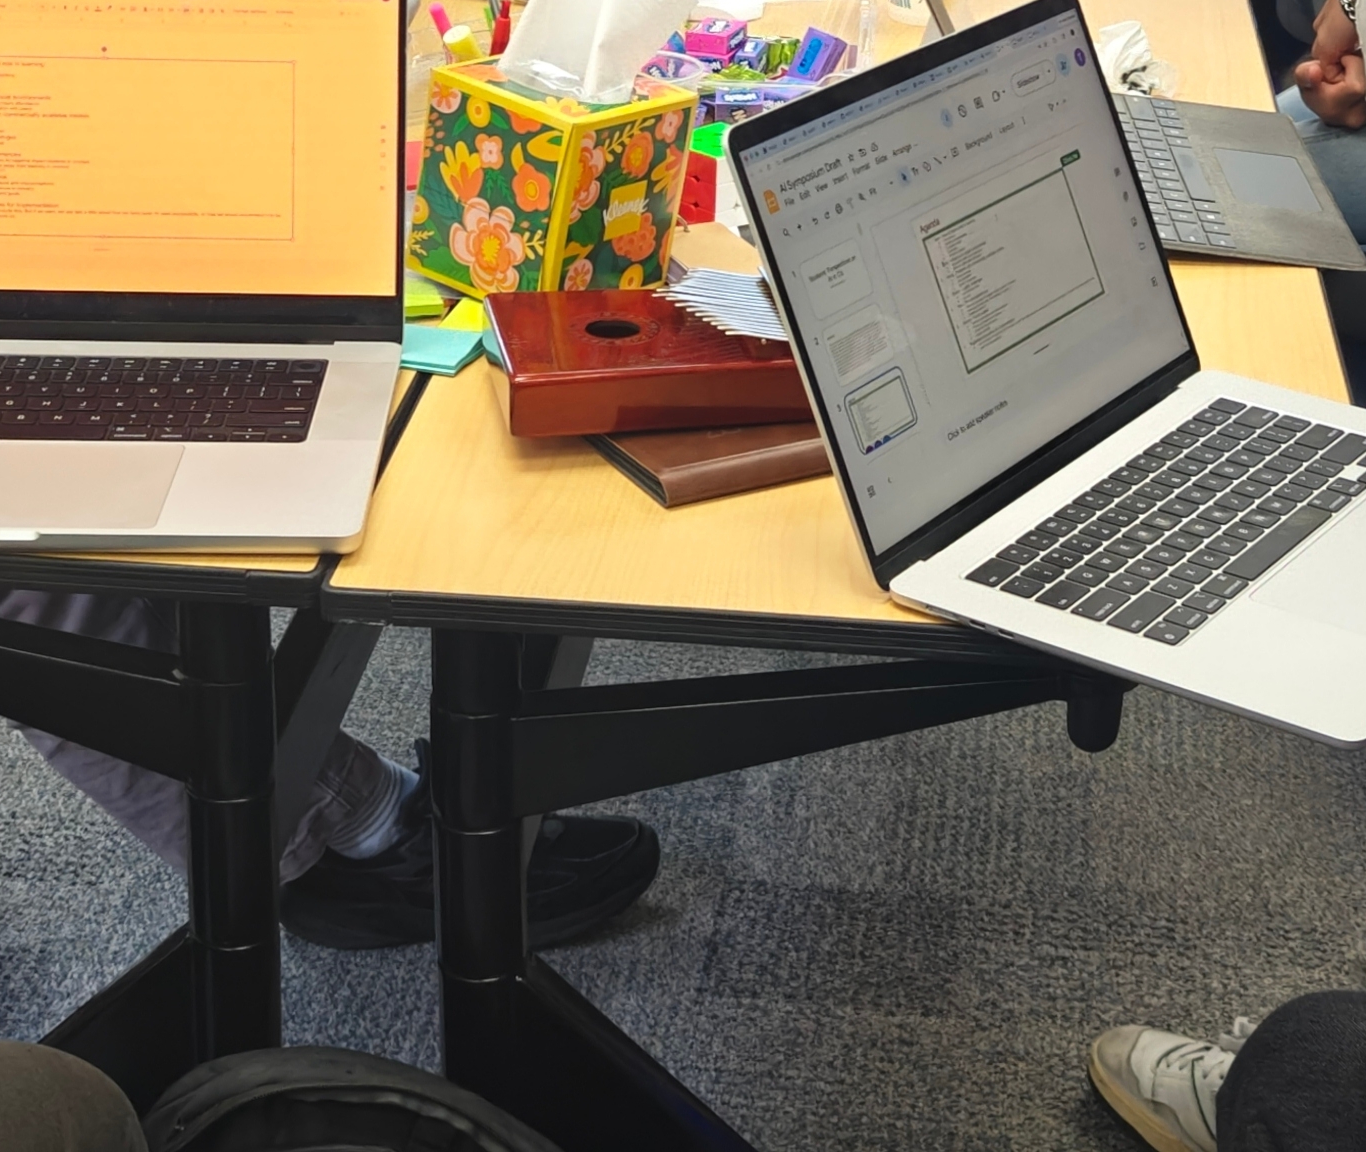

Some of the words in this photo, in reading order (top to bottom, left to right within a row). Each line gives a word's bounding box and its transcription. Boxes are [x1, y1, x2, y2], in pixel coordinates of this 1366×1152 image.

[825, 158, 843, 174] Draft
[602, 198, 650, 227] Kleenex
[919, 218, 941, 234] Agenda
